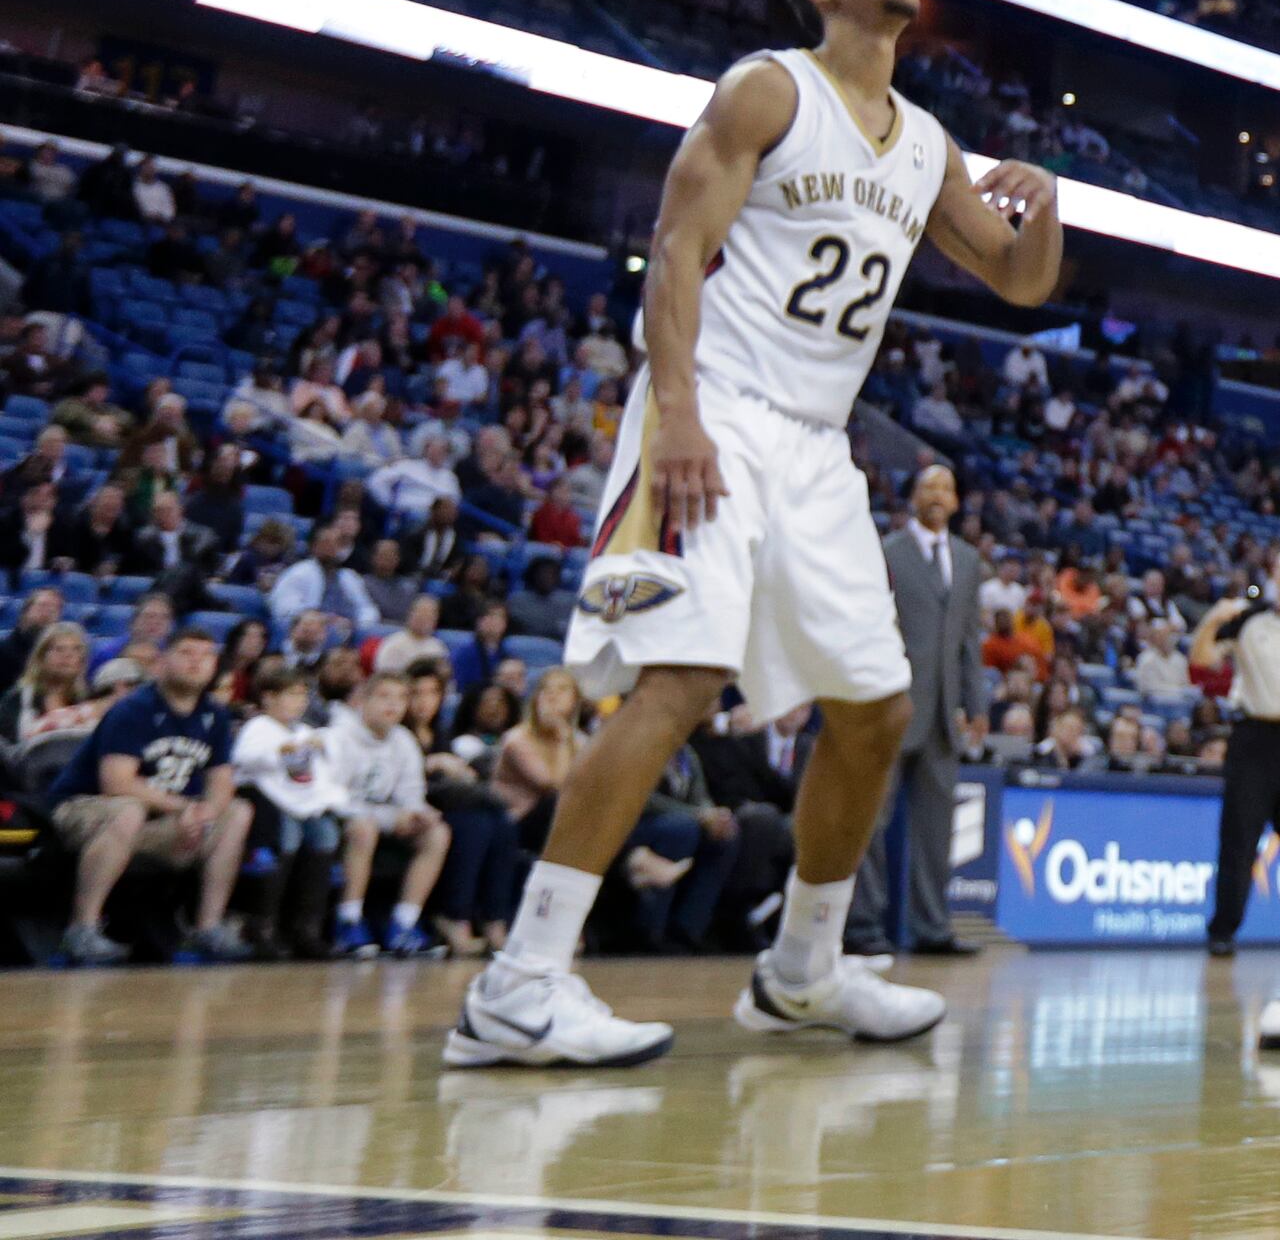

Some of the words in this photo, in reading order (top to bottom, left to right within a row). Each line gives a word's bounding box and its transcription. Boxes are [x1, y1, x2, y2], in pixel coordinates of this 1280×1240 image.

[780, 171, 845, 210] NEW
[783, 233, 892, 342] 22
[1046, 838, 1214, 904] Ochsner
